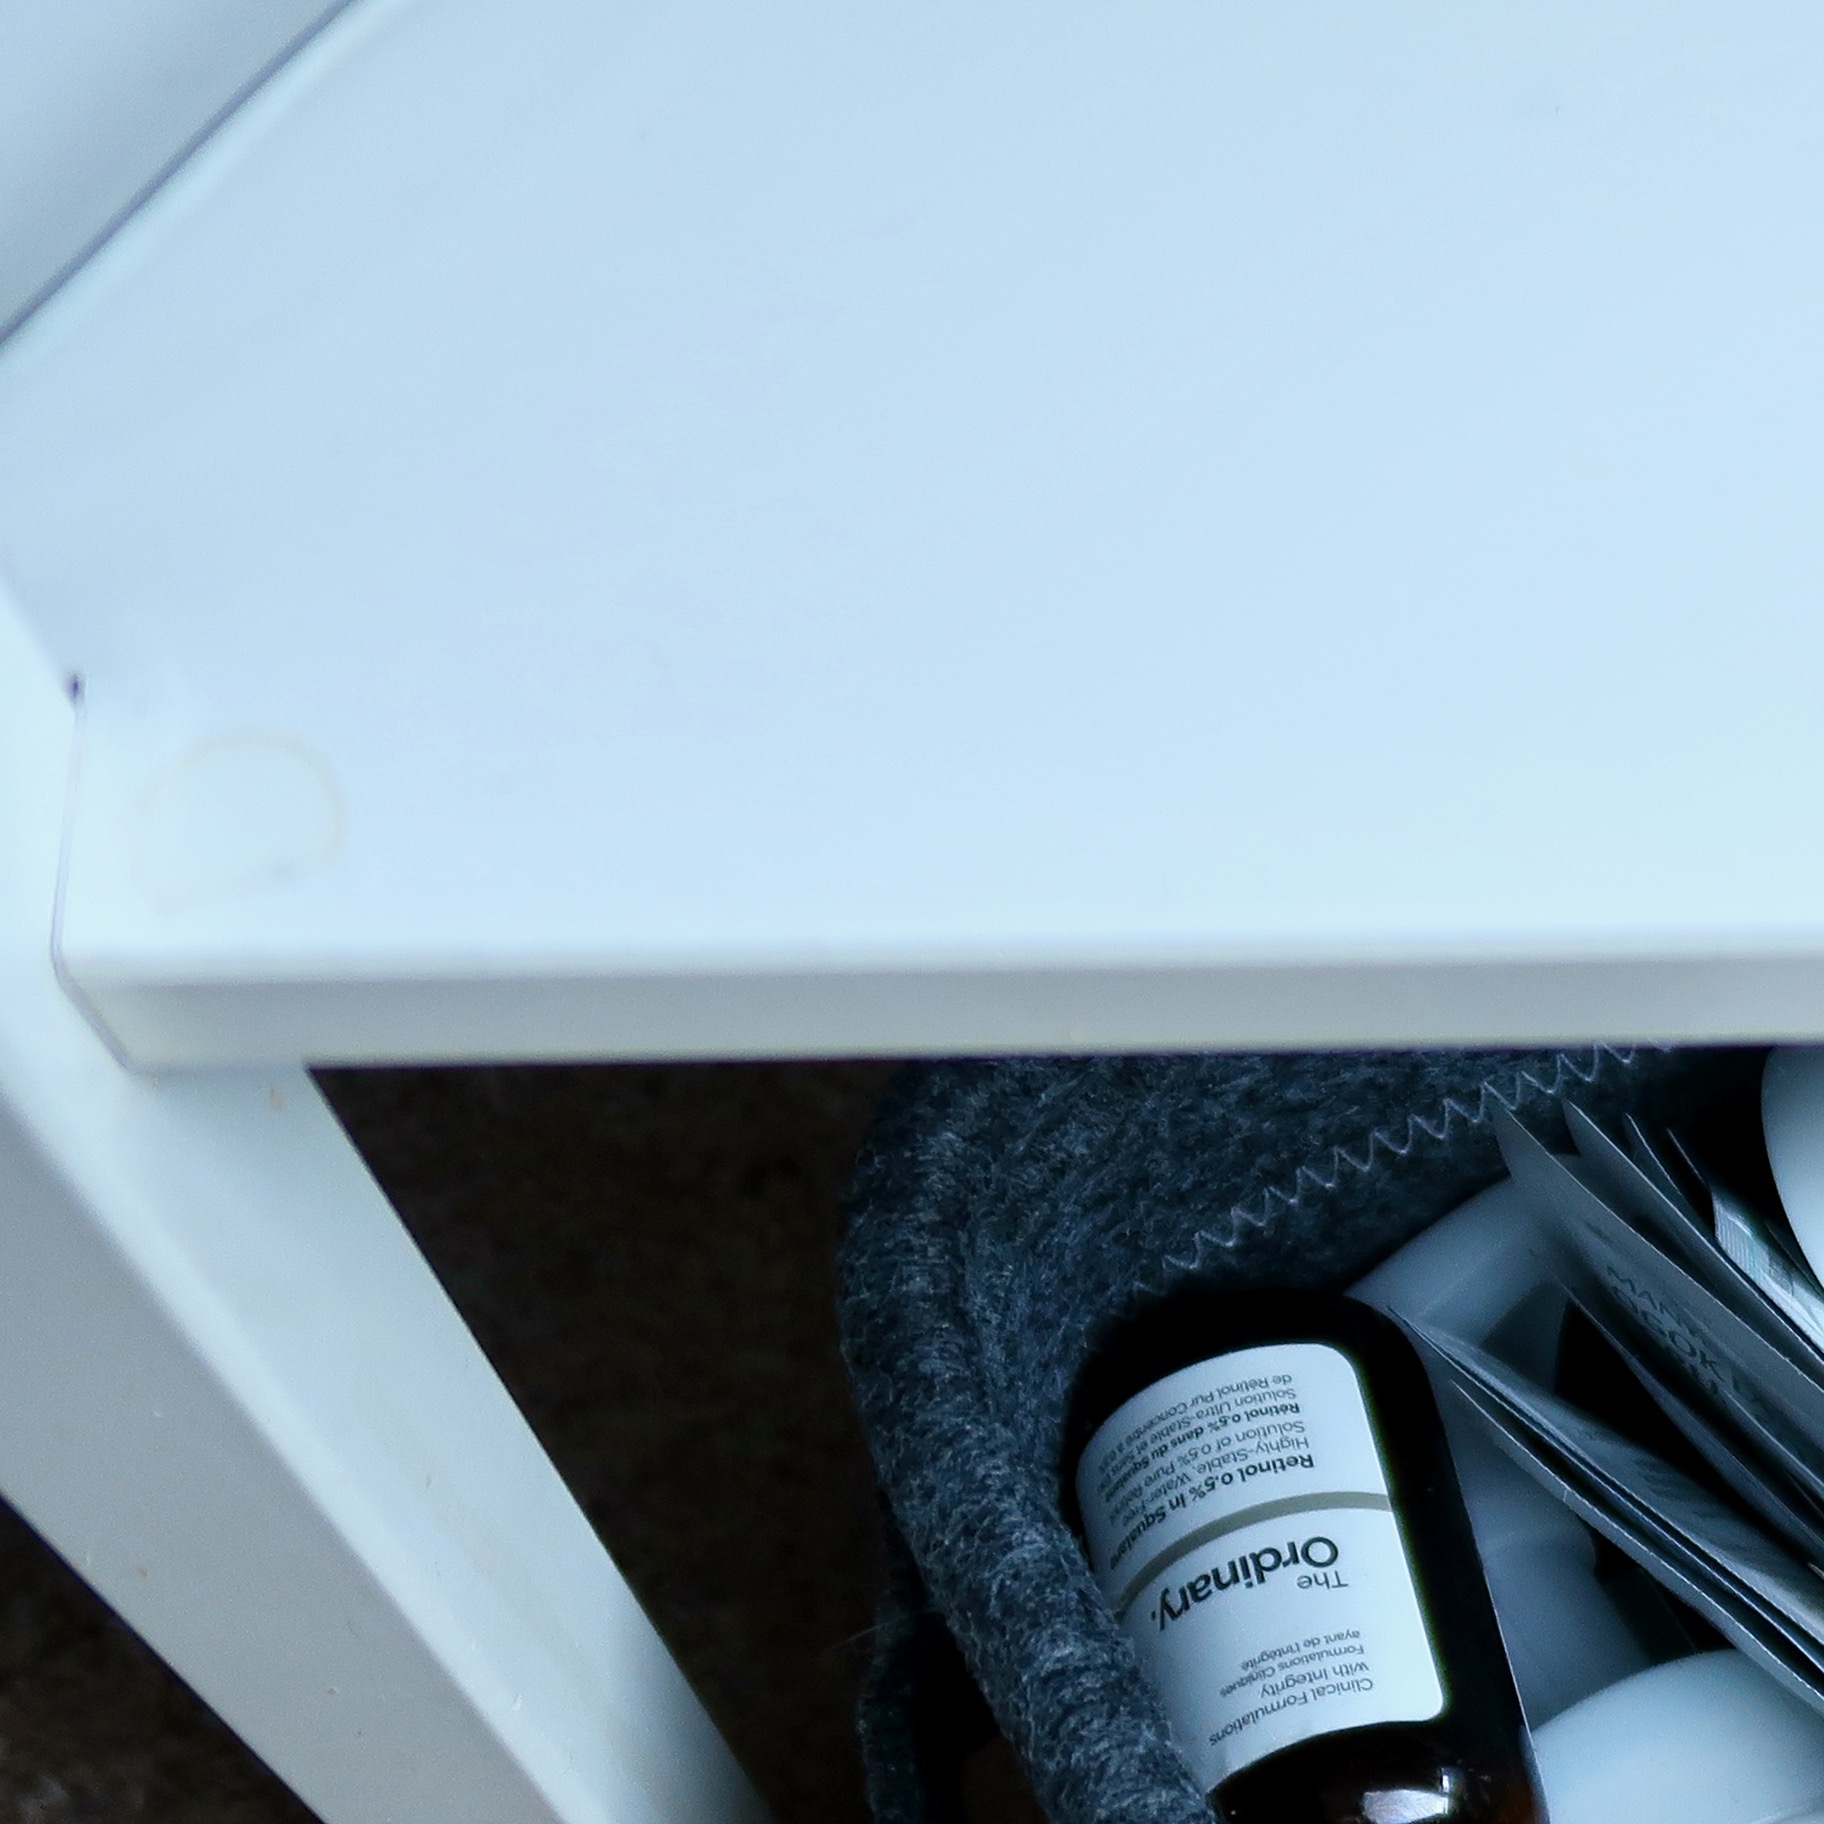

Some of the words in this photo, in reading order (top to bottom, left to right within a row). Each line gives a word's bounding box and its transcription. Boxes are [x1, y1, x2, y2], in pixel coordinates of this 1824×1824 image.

[1216, 1378, 1269, 1399] Rétinol
[1272, 1374, 1292, 1384] de
[1189, 1391, 1214, 1407] Pur
[1234, 1388, 1296, 1406] Solution
[1209, 1413, 1241, 1430] 0.5%
[1244, 1403, 1300, 1421] Rétinol
[1170, 1426, 1203, 1447] dans
[1235, 1421, 1305, 1442] Solution
[1151, 1444, 1167, 1459] du
[1177, 1443, 1211, 1465] 0.5%
[1217, 1436, 1231, 1451] of
[1192, 1436, 1309, 1474] Highly-Stable,
[1238, 1454, 1314, 1482] Retinol
[1189, 1472, 1233, 1500] 0.5%
[1151, 1535, 1339, 1630] Ordinary.
[1296, 1570, 1348, 1589] The
[1300, 1637, 1323, 1648] de
[1323, 1628, 1359, 1643] ayant
[1277, 1644, 1364, 1670] Formulations
[1332, 1661, 1369, 1676] with
[1220, 1666, 1275, 1696] Cliniques
[1310, 1678, 1373, 1700] Clinical
[1209, 1691, 1307, 1742] Formulations
